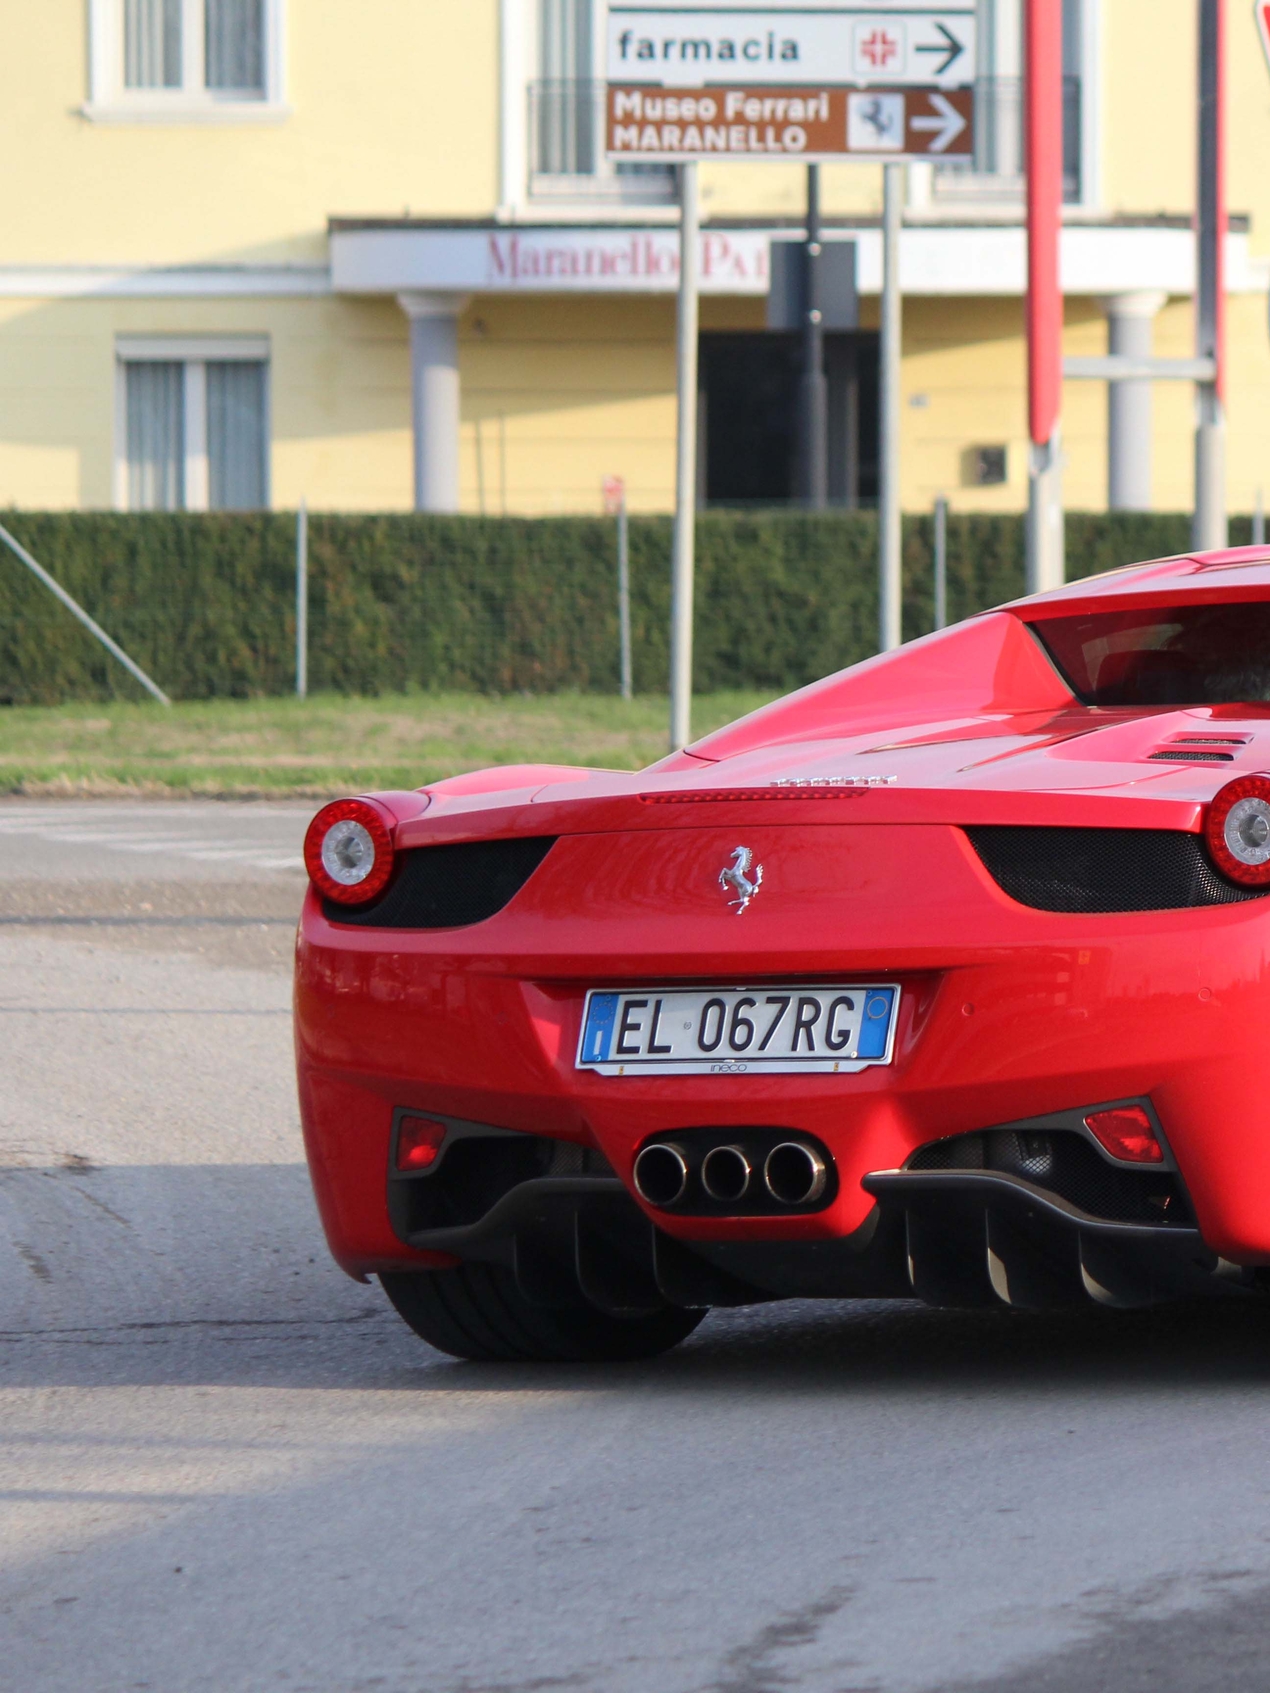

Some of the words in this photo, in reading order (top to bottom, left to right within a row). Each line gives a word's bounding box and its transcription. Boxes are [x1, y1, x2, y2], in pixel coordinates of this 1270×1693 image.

[619, 31, 799, 60] farmacia
[614, 91, 717, 121] Museo
[725, 91, 829, 121] Ferrari
[613, 125, 807, 151] MARANELLO
[487, 231, 681, 277] Maranello
[616, 999, 673, 1055] EL
[697, 995, 856, 1053] 067RG
